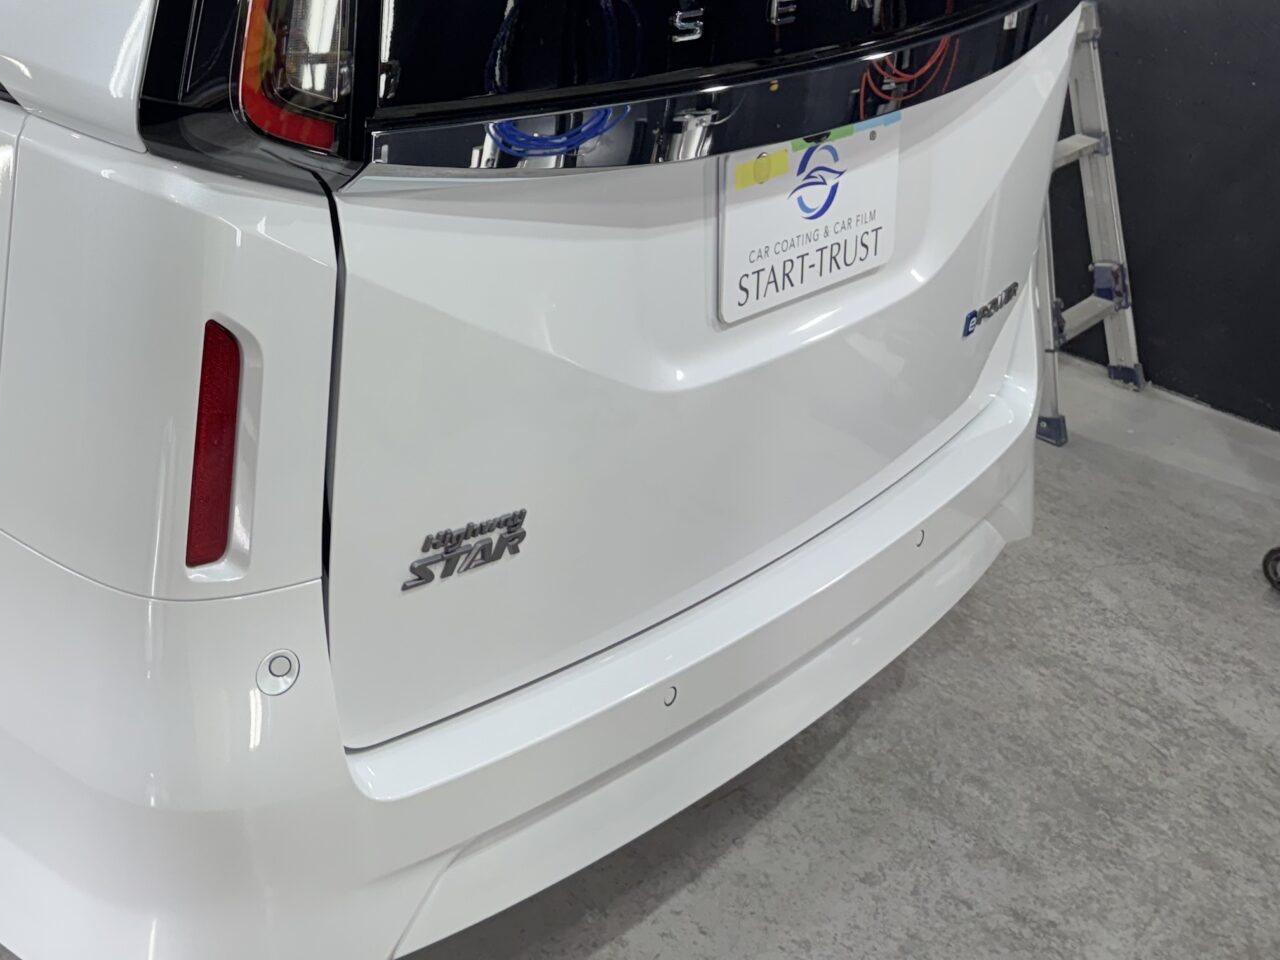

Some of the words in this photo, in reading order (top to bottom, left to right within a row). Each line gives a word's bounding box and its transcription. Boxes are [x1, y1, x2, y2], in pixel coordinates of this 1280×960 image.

[748, 245, 770, 264] CAR
[773, 228, 820, 255] COATING
[823, 224, 830, 239] &
[833, 216, 853, 234] CAR
[855, 209, 877, 228] FILM
[737, 226, 883, 307] START-TRUST
[401, 527, 527, 591] STAR
[421, 508, 527, 554] Highway
